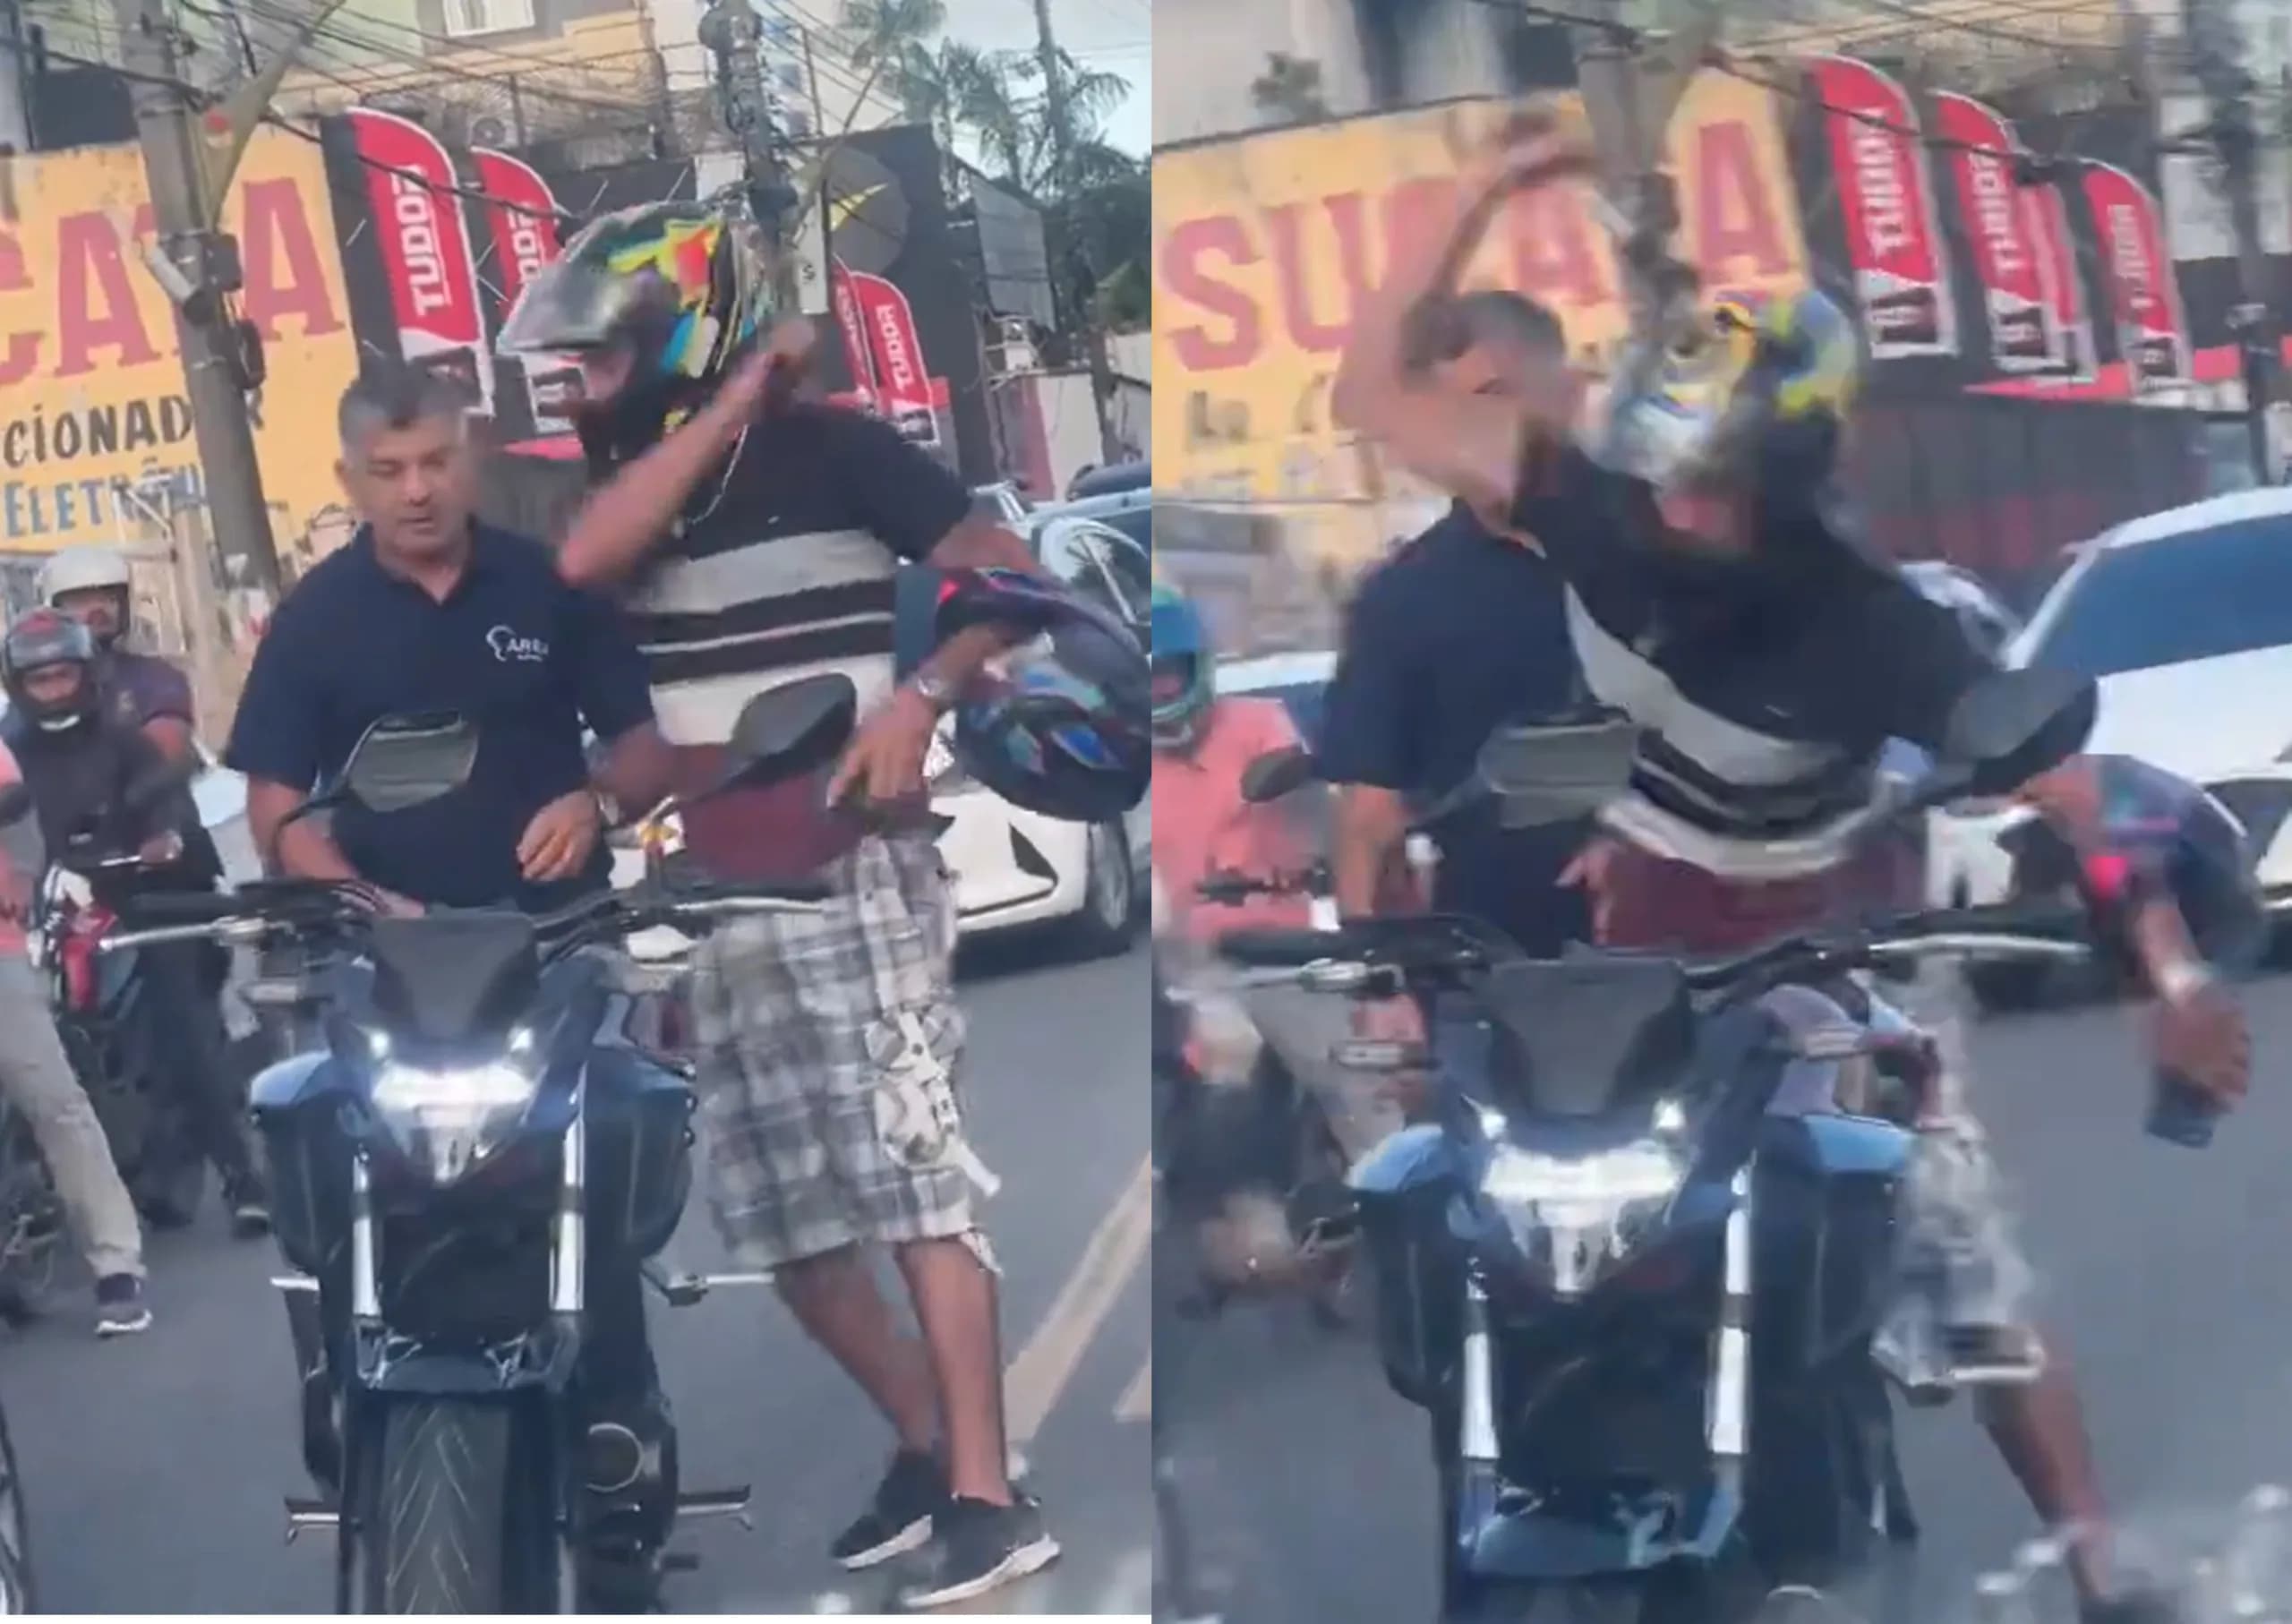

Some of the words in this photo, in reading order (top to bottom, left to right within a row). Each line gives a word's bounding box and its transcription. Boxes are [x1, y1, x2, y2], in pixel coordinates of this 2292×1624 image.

[0, 176, 346, 387] AA
[390, 164, 452, 317] TUDOR
[1165, 122, 1786, 372] SUAA
